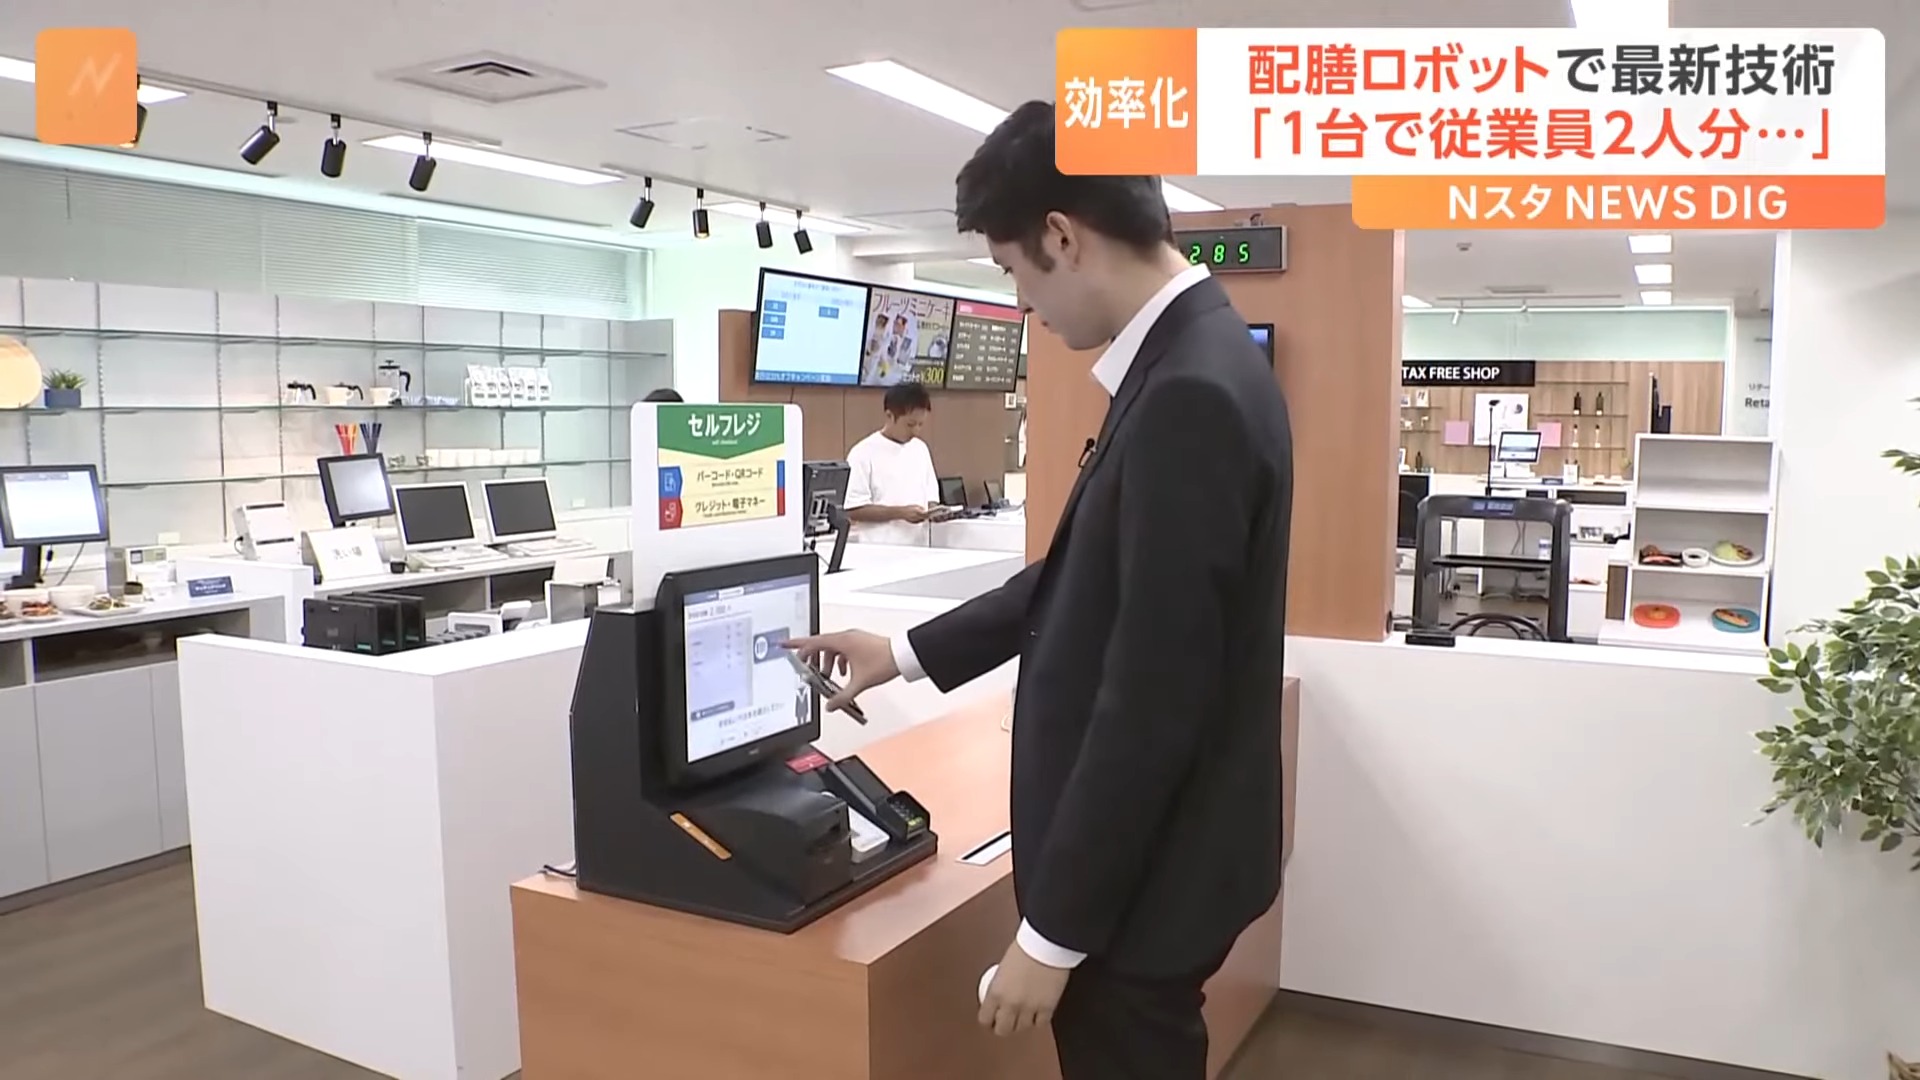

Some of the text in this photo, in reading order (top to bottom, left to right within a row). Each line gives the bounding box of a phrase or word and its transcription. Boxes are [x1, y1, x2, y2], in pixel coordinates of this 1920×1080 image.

[872, 292, 952, 321] フルーツミニケーキ
[1402, 366, 1500, 380] TAX FREE SHOP
[687, 412, 762, 438] セルフレジ
[697, 467, 764, 483] バーコード・QRコード
[695, 496, 766, 514] クレジット・電子マネー
